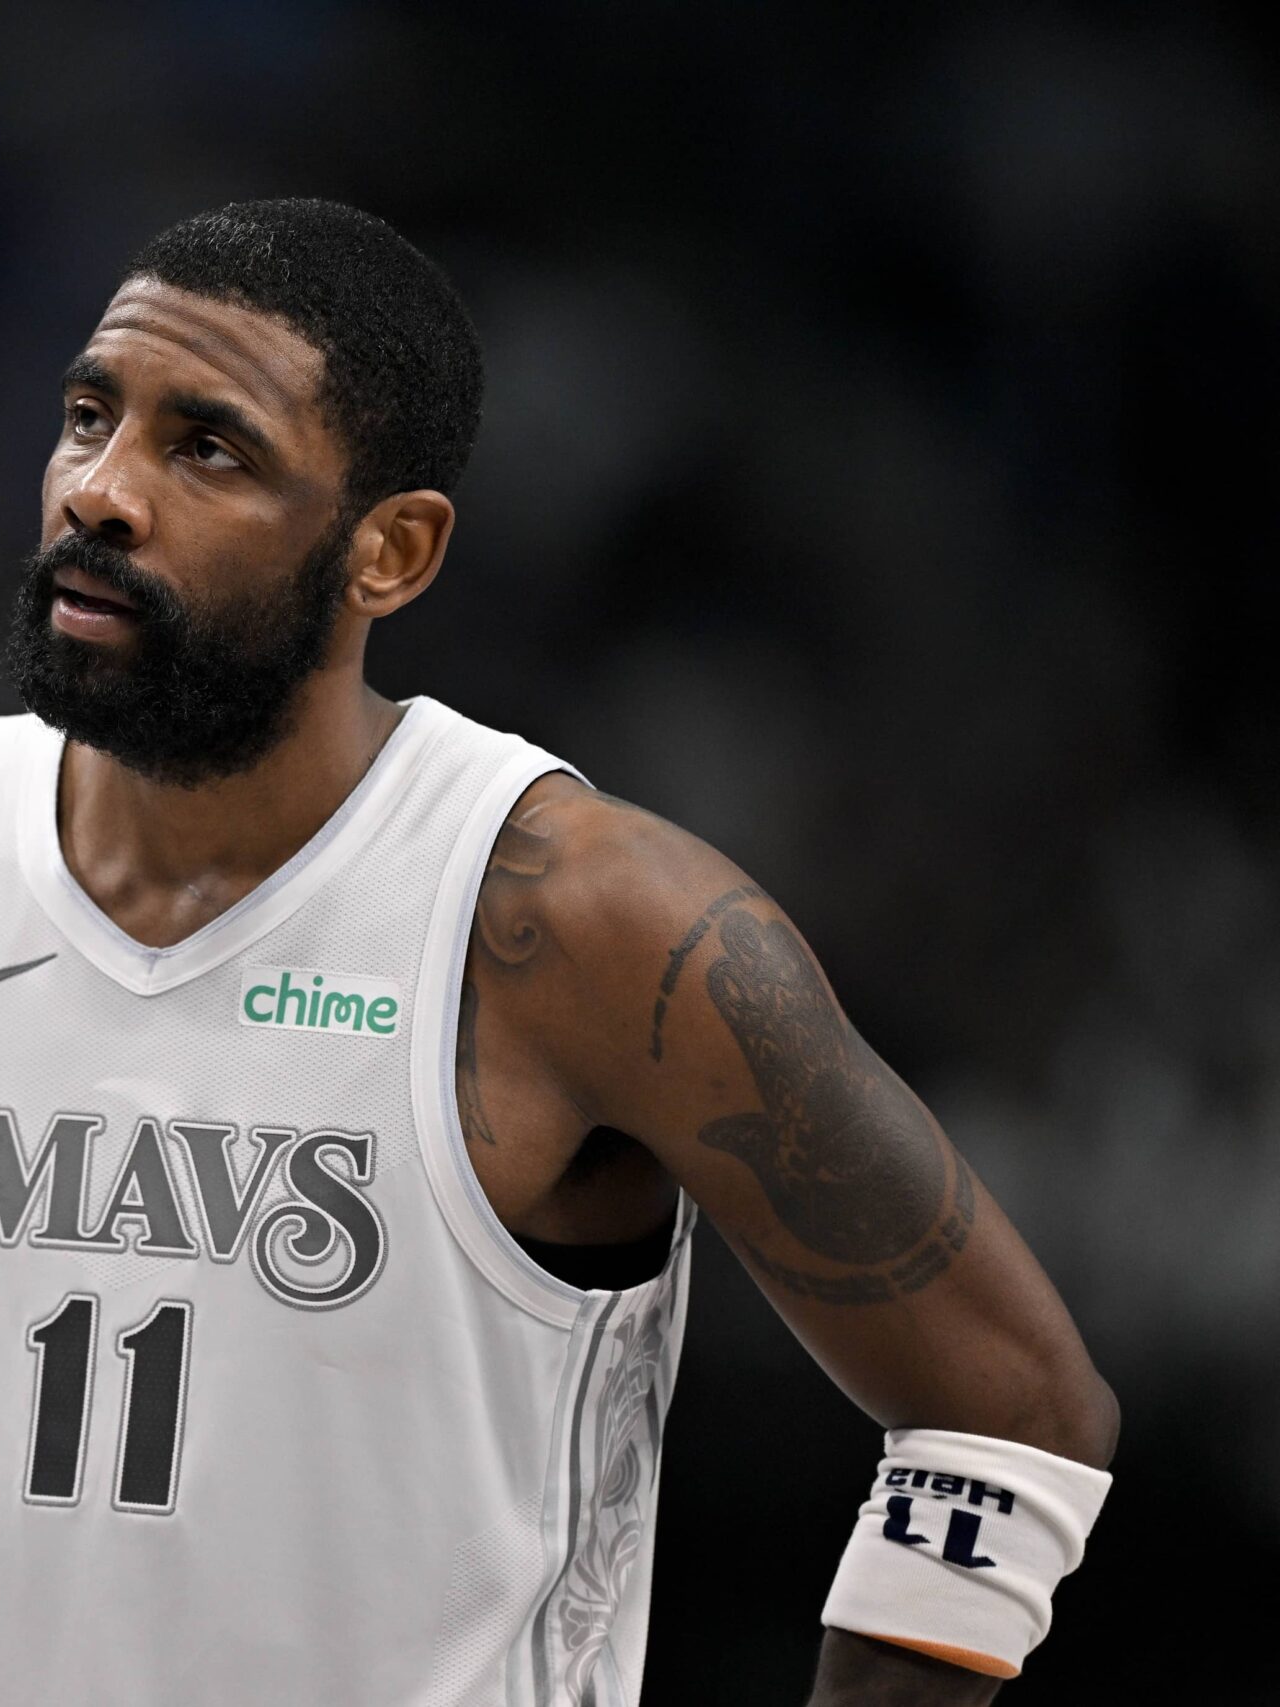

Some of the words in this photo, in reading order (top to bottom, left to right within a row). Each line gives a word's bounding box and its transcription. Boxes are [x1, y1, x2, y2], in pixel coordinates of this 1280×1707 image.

[244, 972, 398, 1034] chime
[22, 1291, 195, 1517] 11
[882, 1496, 998, 1569] 11
